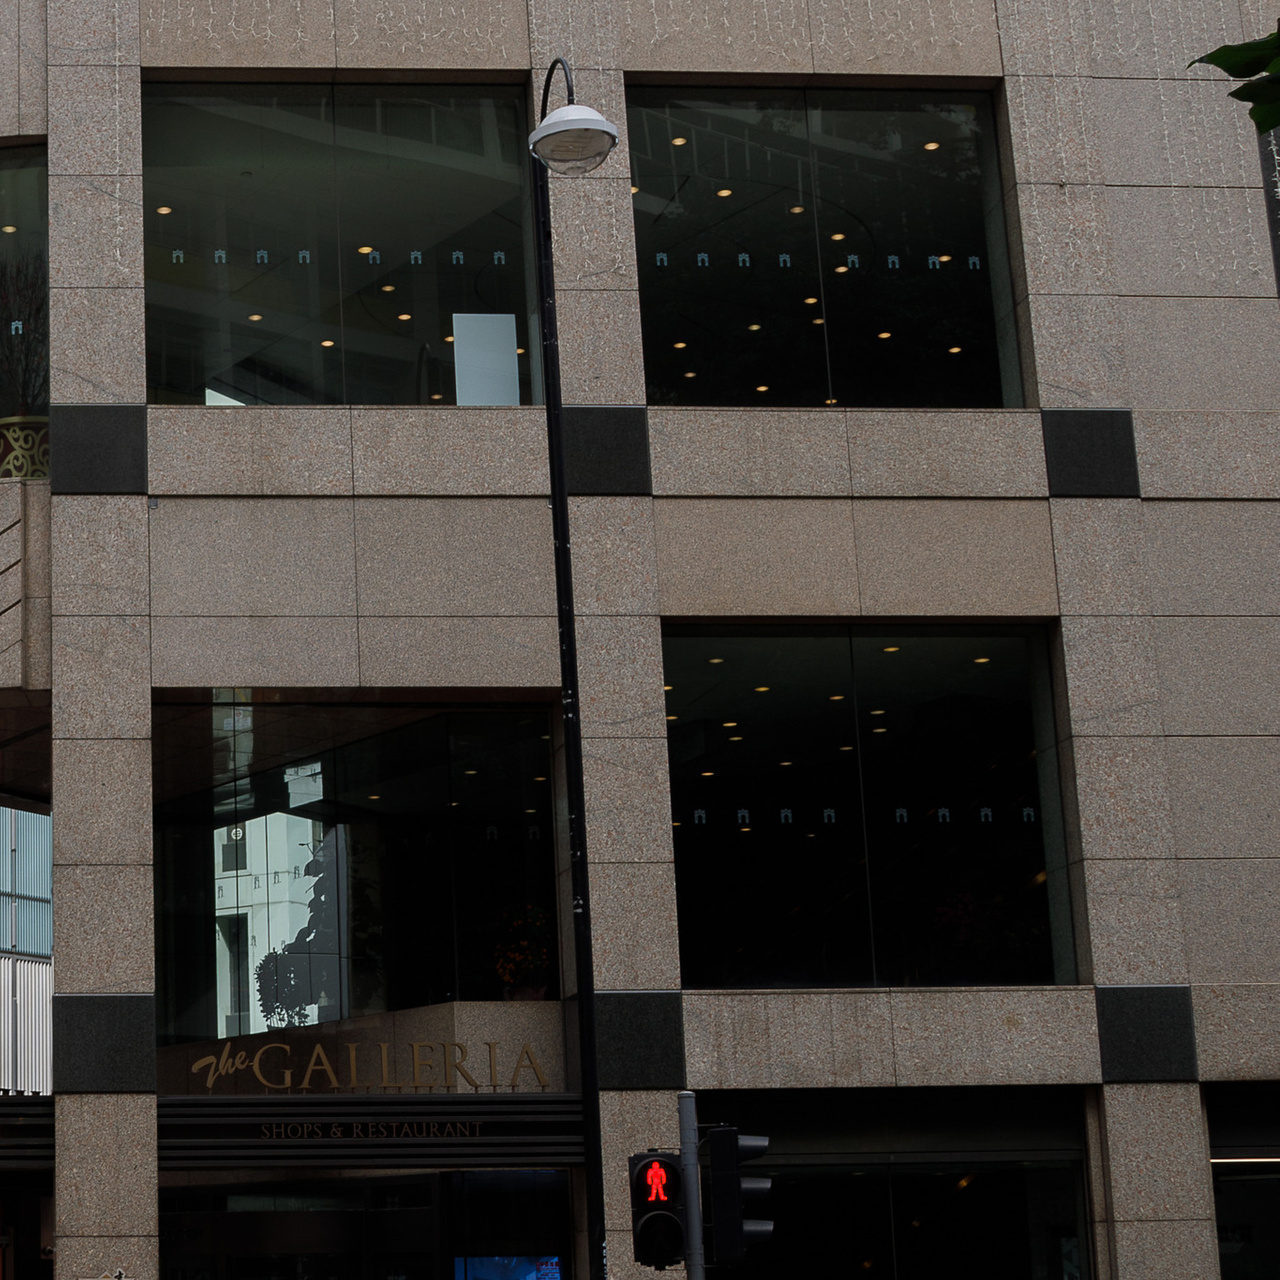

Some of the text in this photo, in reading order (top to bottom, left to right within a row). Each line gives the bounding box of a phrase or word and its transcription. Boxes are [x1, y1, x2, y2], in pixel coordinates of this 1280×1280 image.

[191, 1041, 550, 1089] The GALLERIA
[260, 1121, 484, 1140] SHOPS & RESTAURANT
